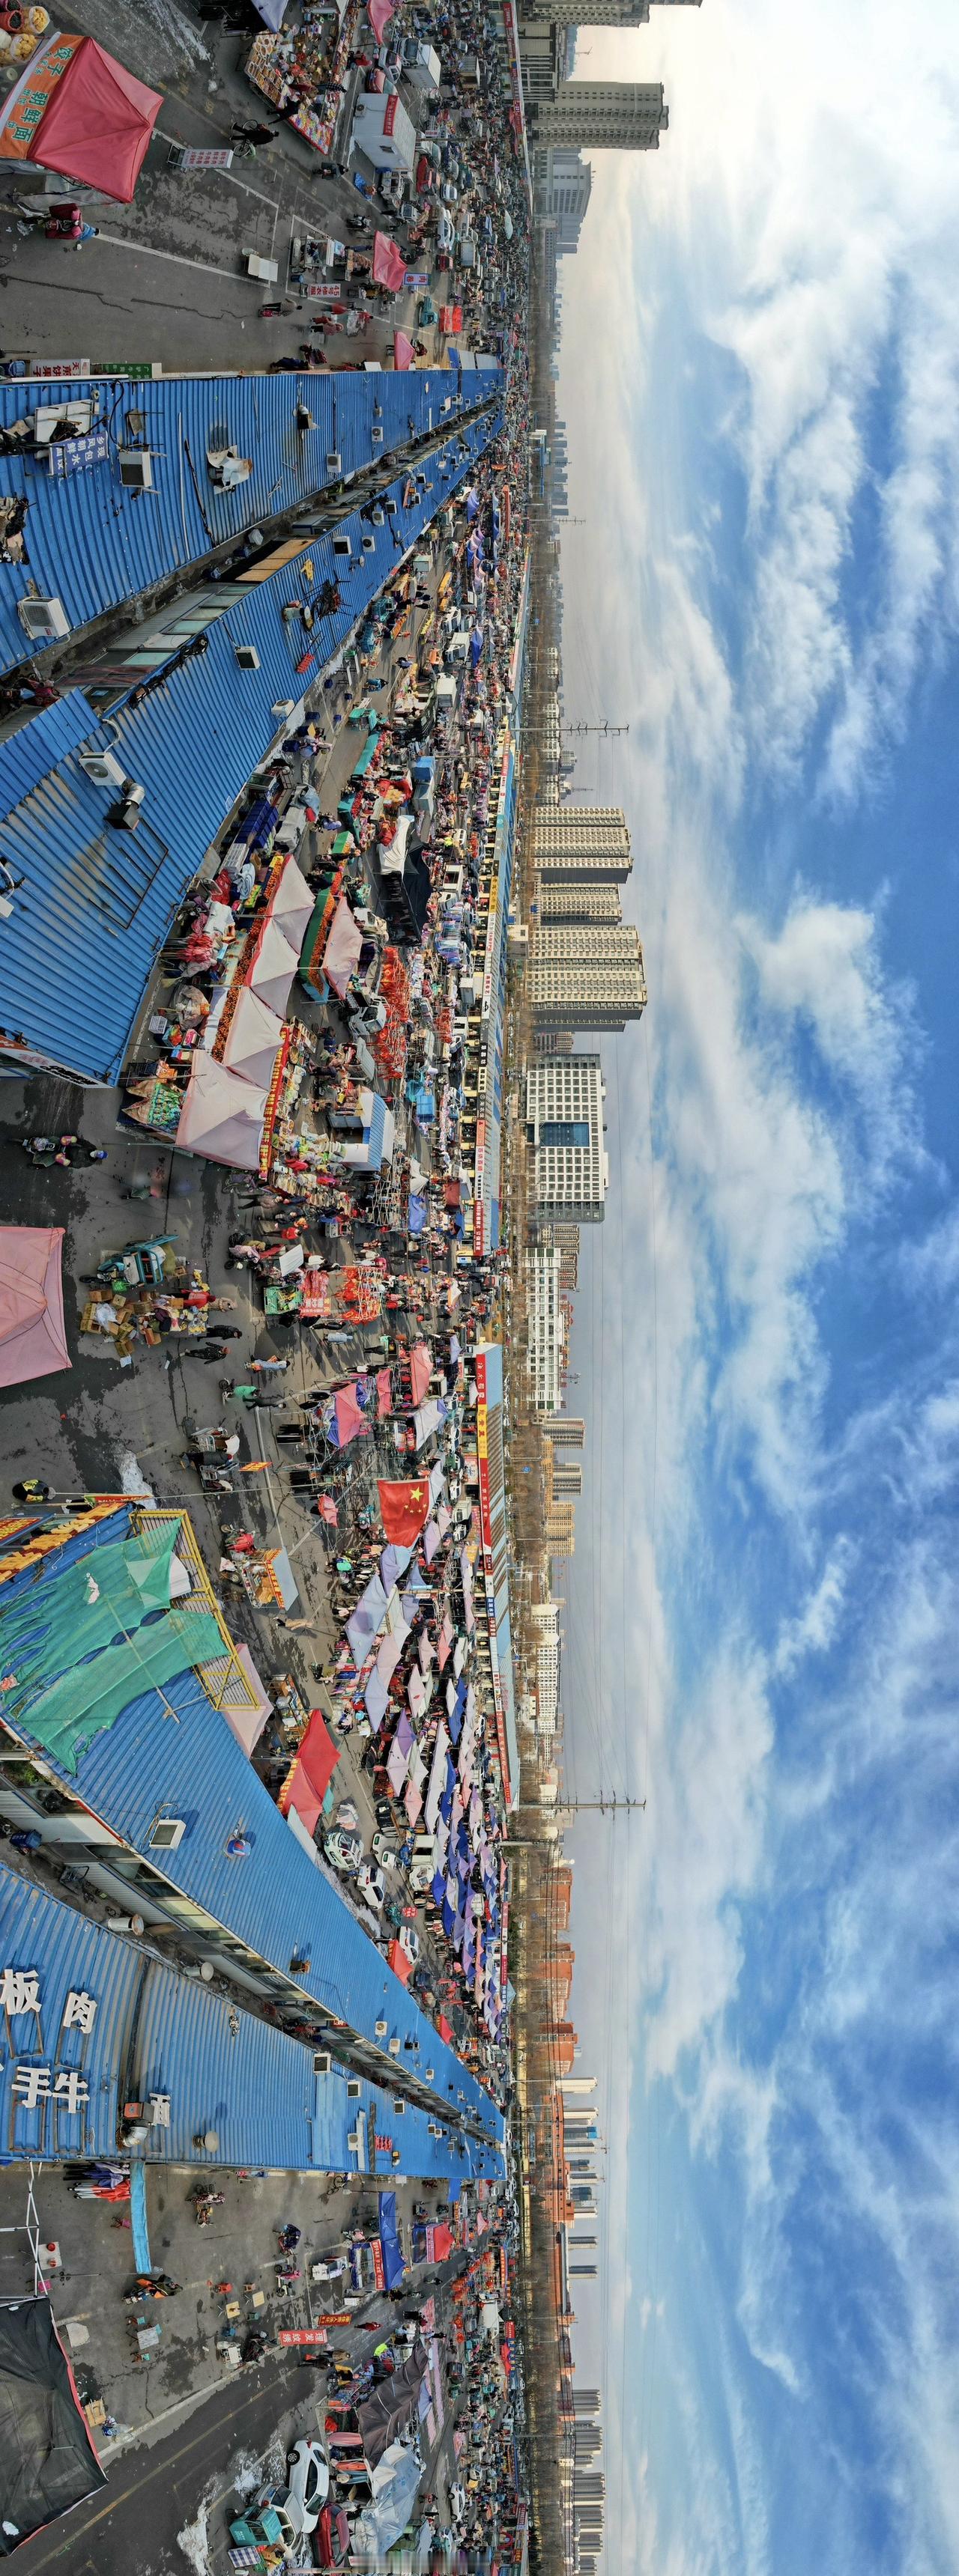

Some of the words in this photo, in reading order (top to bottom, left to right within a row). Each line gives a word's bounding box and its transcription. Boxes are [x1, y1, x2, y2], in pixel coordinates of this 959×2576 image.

[46, 47, 73, 76] 饺子
[11, 91, 49, 142] 朝鲜面
[305, 2333, 324, 2342] 理发
